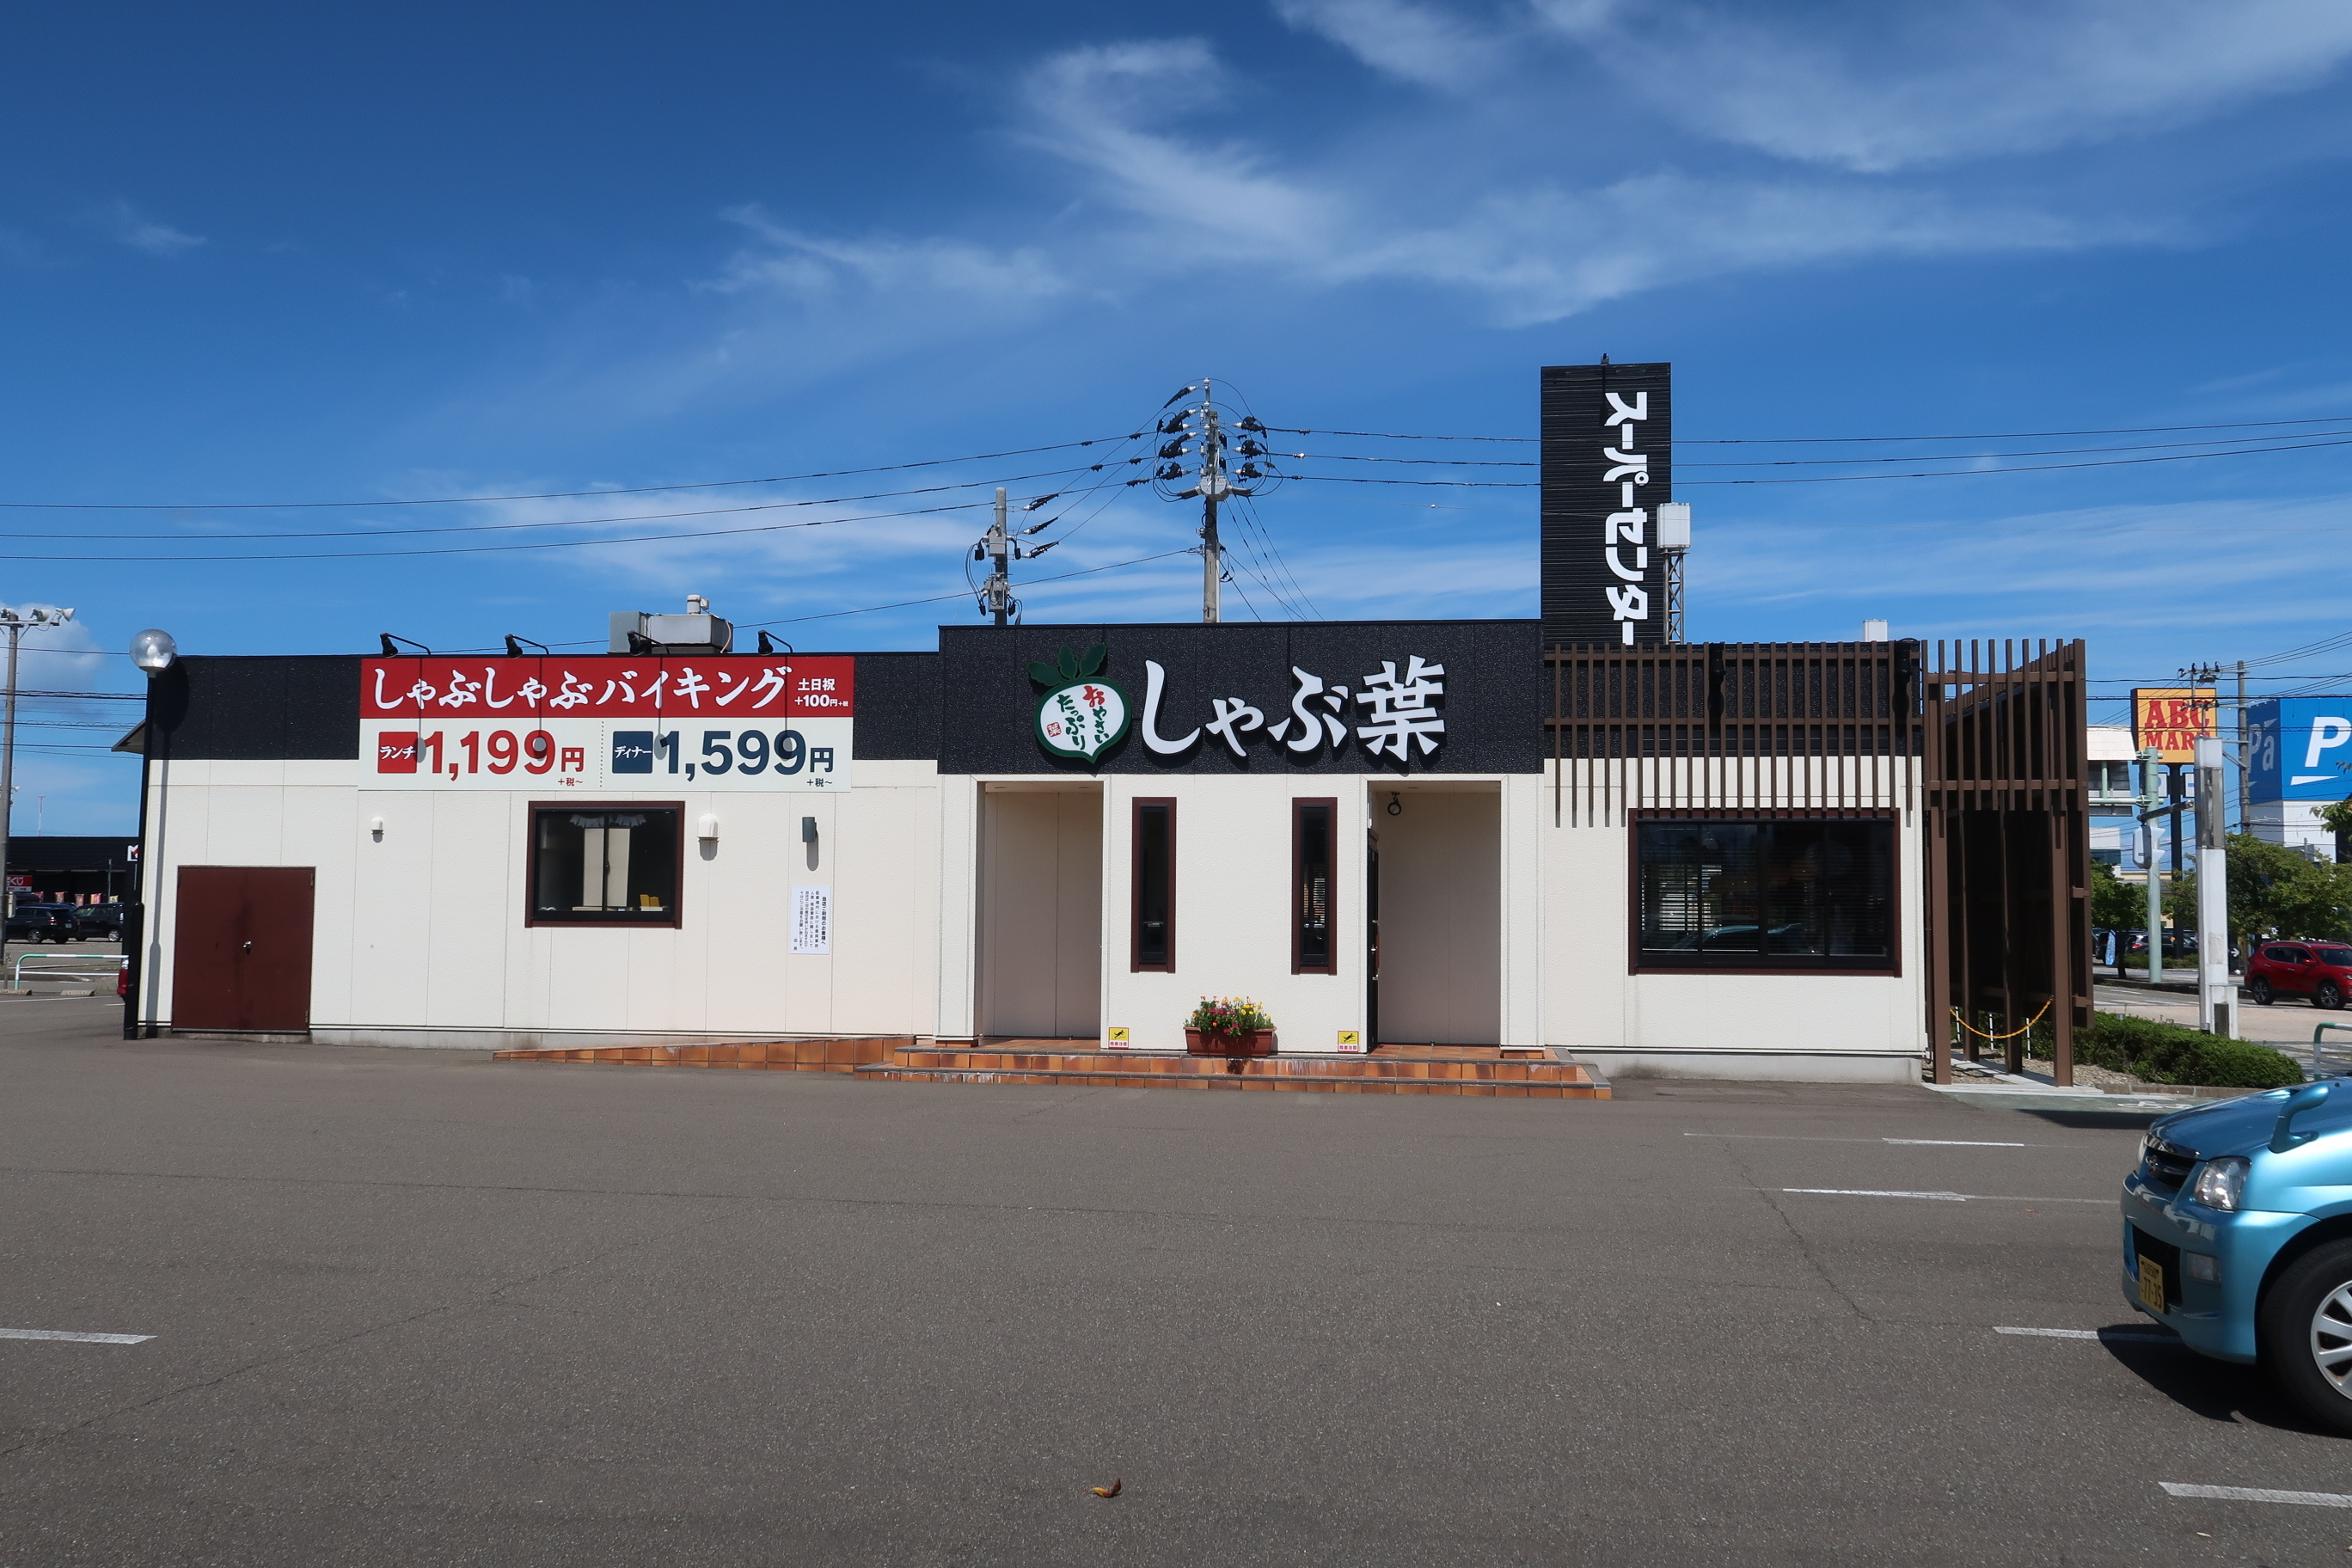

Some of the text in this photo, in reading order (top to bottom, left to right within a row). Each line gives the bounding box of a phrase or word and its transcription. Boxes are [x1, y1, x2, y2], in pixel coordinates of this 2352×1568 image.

[1602, 391, 1650, 646] スーパーセンター
[374, 665, 793, 710] しゃぶしゃぶバイキング
[797, 677, 836, 691] 土日祝
[1142, 654, 1446, 763] しゃぶ葉
[1056, 694, 1086, 750] たっぷり
[1082, 684, 1110, 744] おやさい
[2144, 700, 2211, 729] ABC
[379, 729, 585, 781] ランチ 1,199円
[614, 729, 834, 782] ディナー 1,599円
[2145, 731, 2211, 750] MAR
